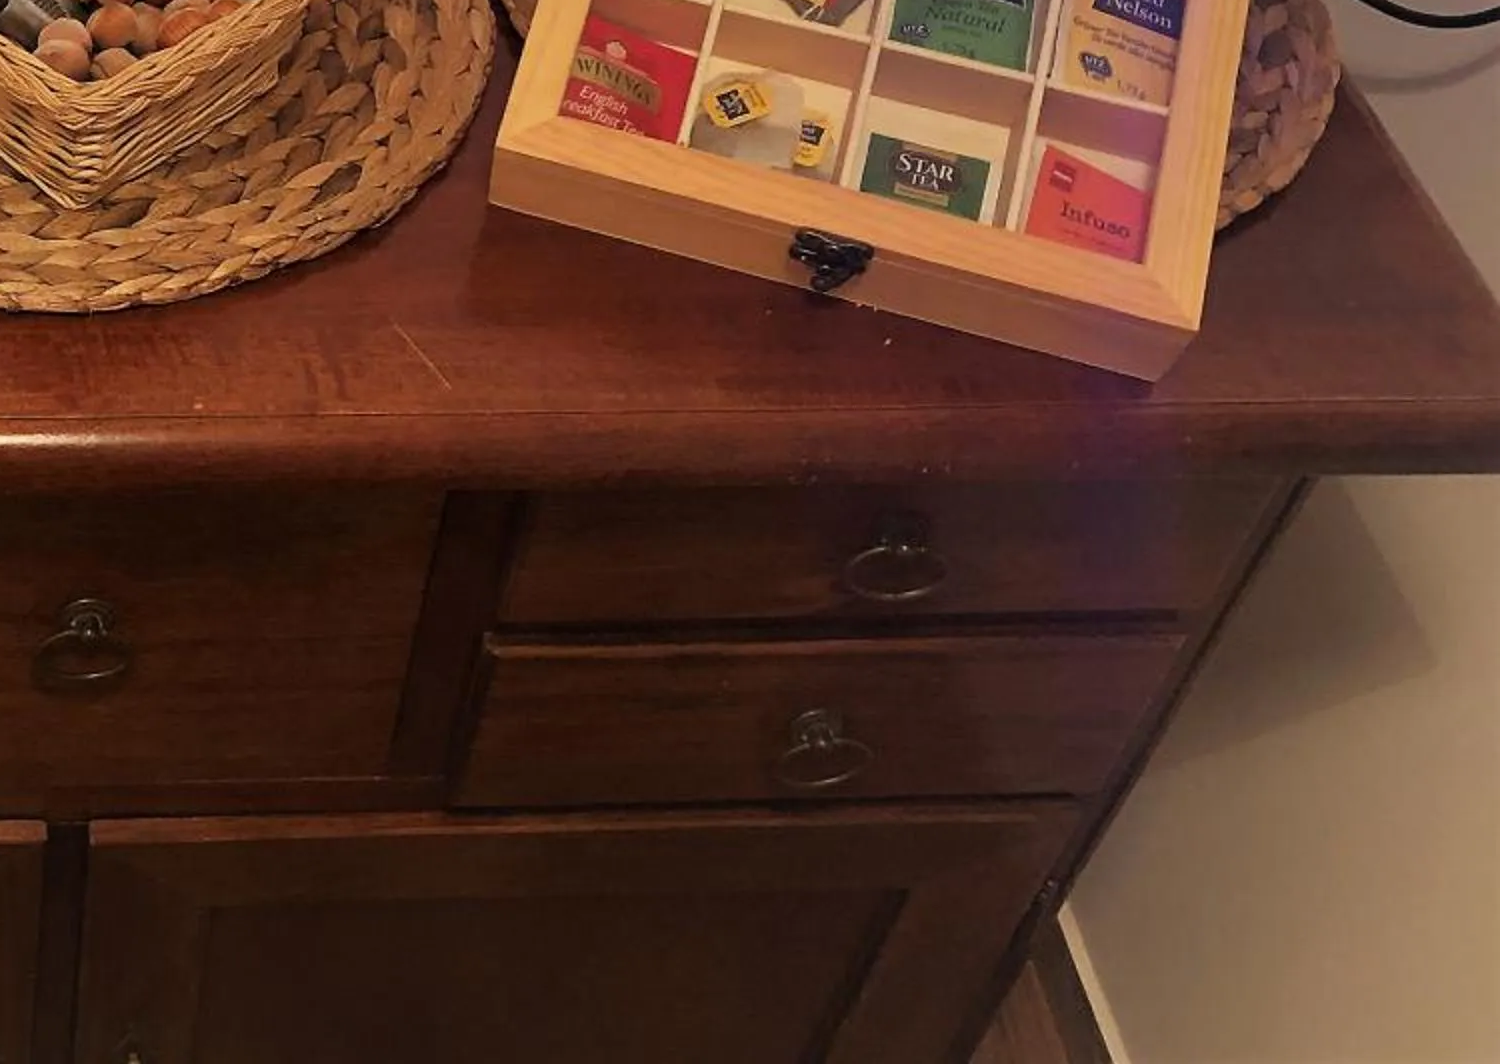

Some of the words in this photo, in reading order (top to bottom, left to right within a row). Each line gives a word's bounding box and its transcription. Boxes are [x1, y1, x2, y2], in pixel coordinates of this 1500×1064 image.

[925, 4, 1006, 34] Natural
[579, 85, 629, 116] English
[896, 152, 955, 182] STAR
